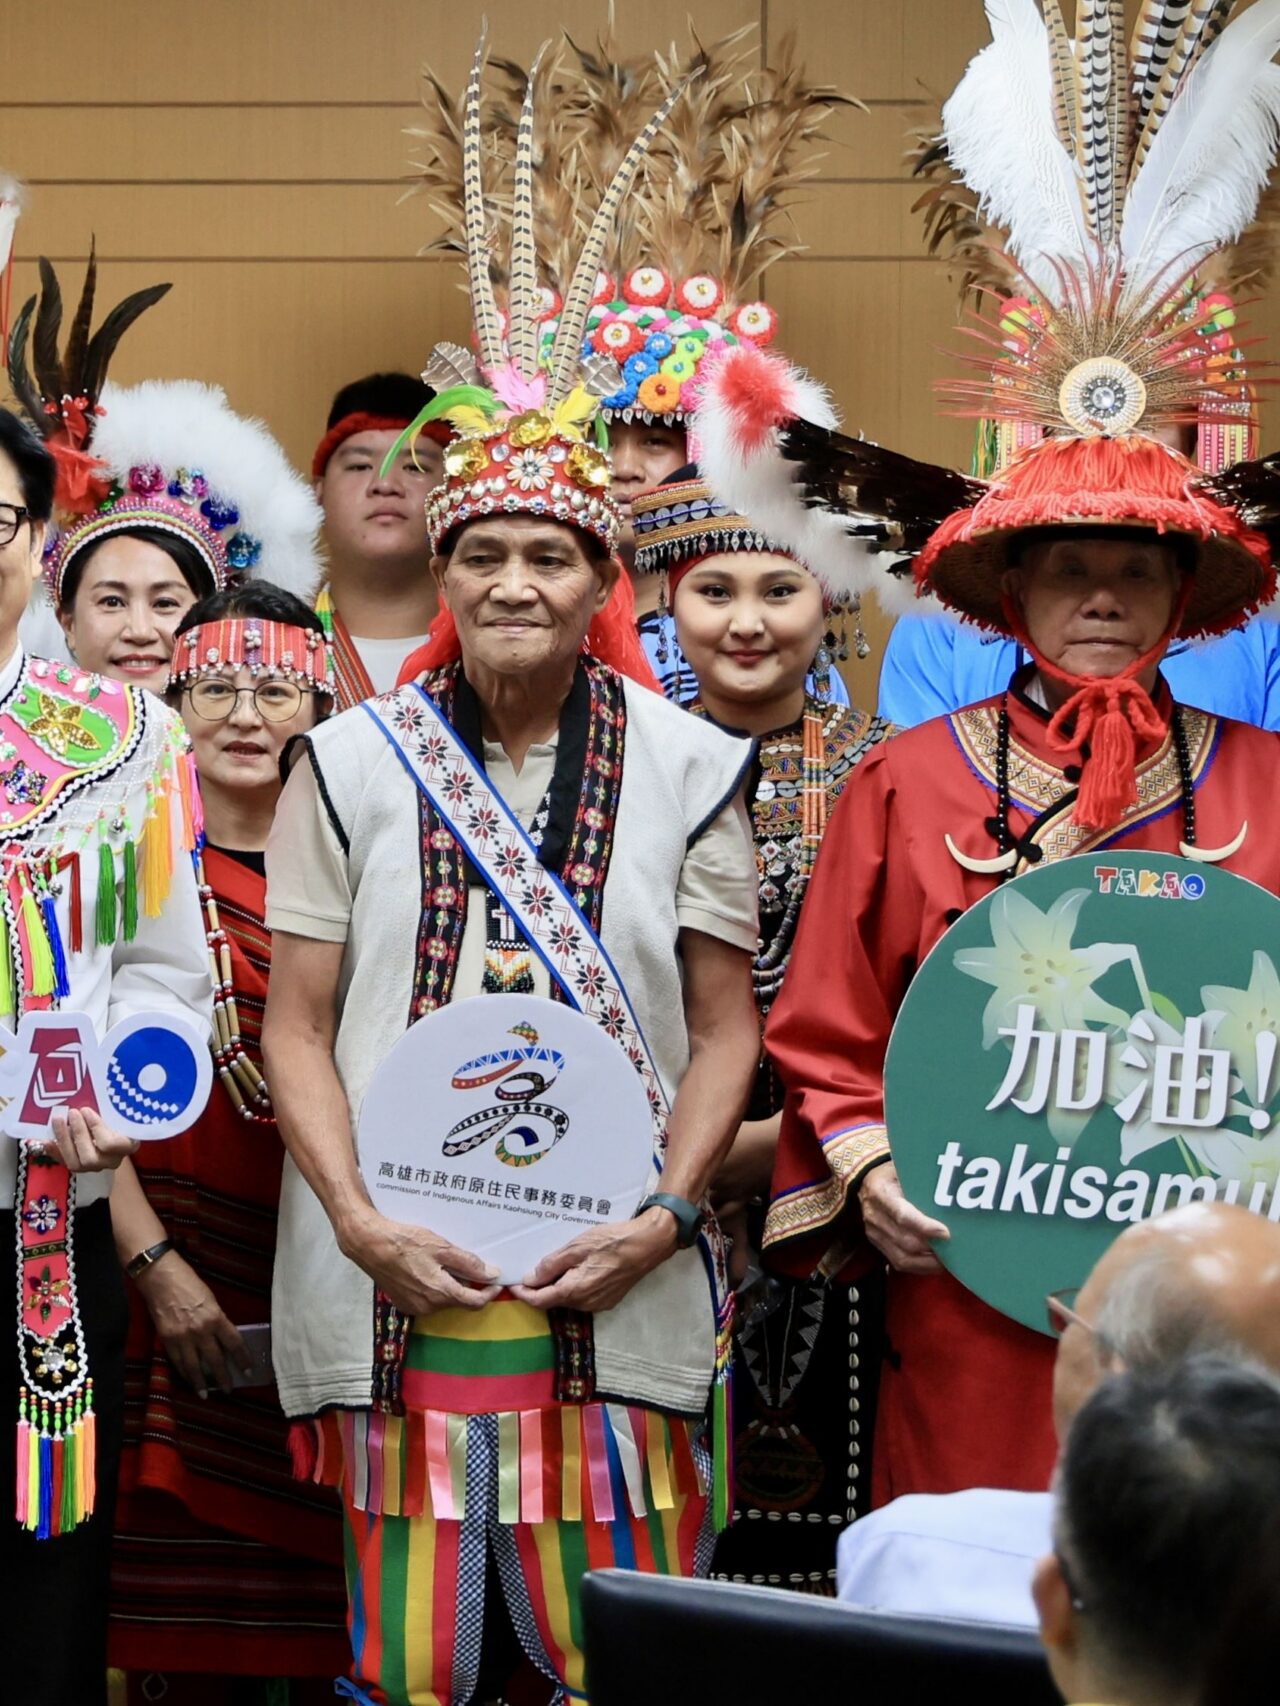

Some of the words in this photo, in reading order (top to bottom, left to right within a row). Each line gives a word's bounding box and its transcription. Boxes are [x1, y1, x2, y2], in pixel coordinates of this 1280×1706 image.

[1094, 866, 1206, 900] TAKAO
[378, 1161, 612, 1216] 高雄市政府原住民事務委員會
[432, 1191, 474, 1205] Indigenous
[476, 1198, 501, 1210] Affairs
[503, 1204, 543, 1218] Kaohsiung
[545, 1210, 560, 1220] City
